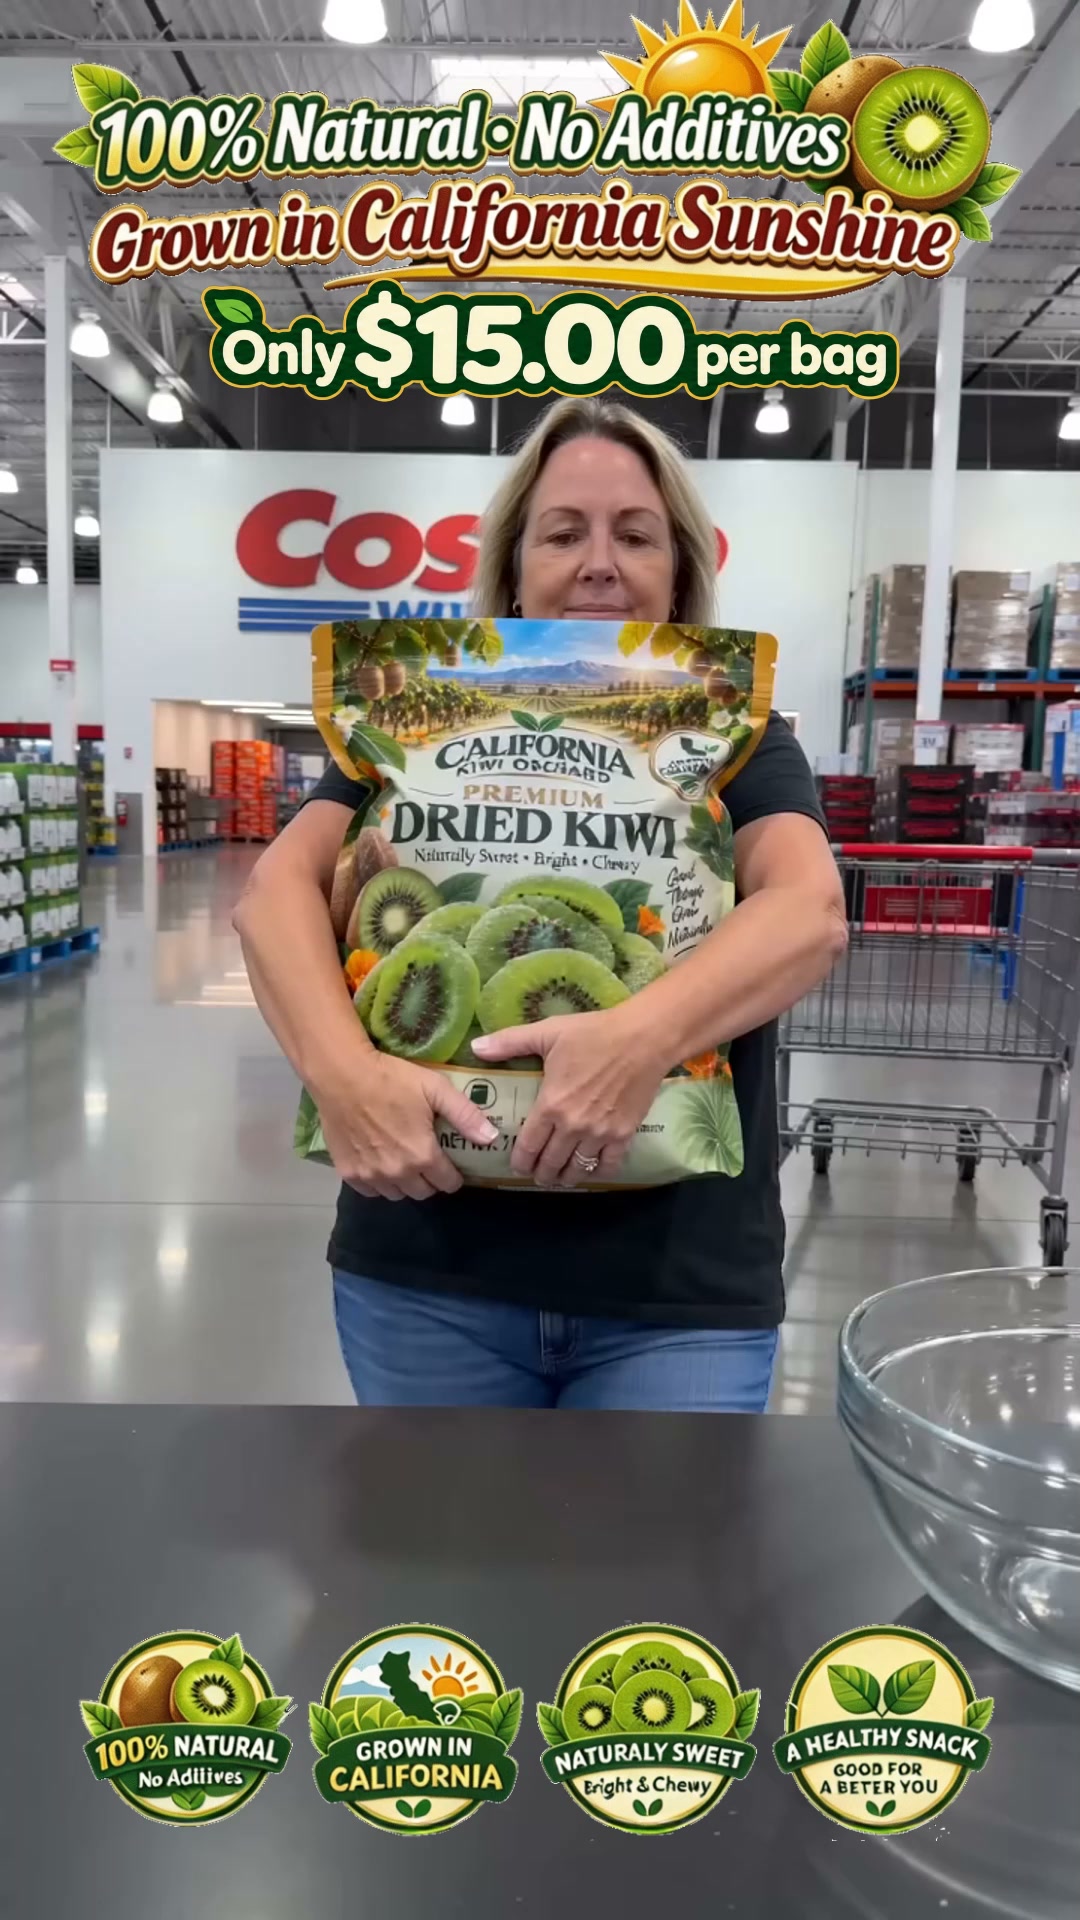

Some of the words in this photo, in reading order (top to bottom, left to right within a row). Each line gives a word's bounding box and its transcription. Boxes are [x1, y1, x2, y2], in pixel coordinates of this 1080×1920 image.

[435, 734, 635, 779] CALIFORNIA
[456, 759, 503, 777] KIWI
[463, 784, 603, 808] PREMIUM
[391, 802, 552, 844] DRIED
[563, 811, 678, 860] KIWI
